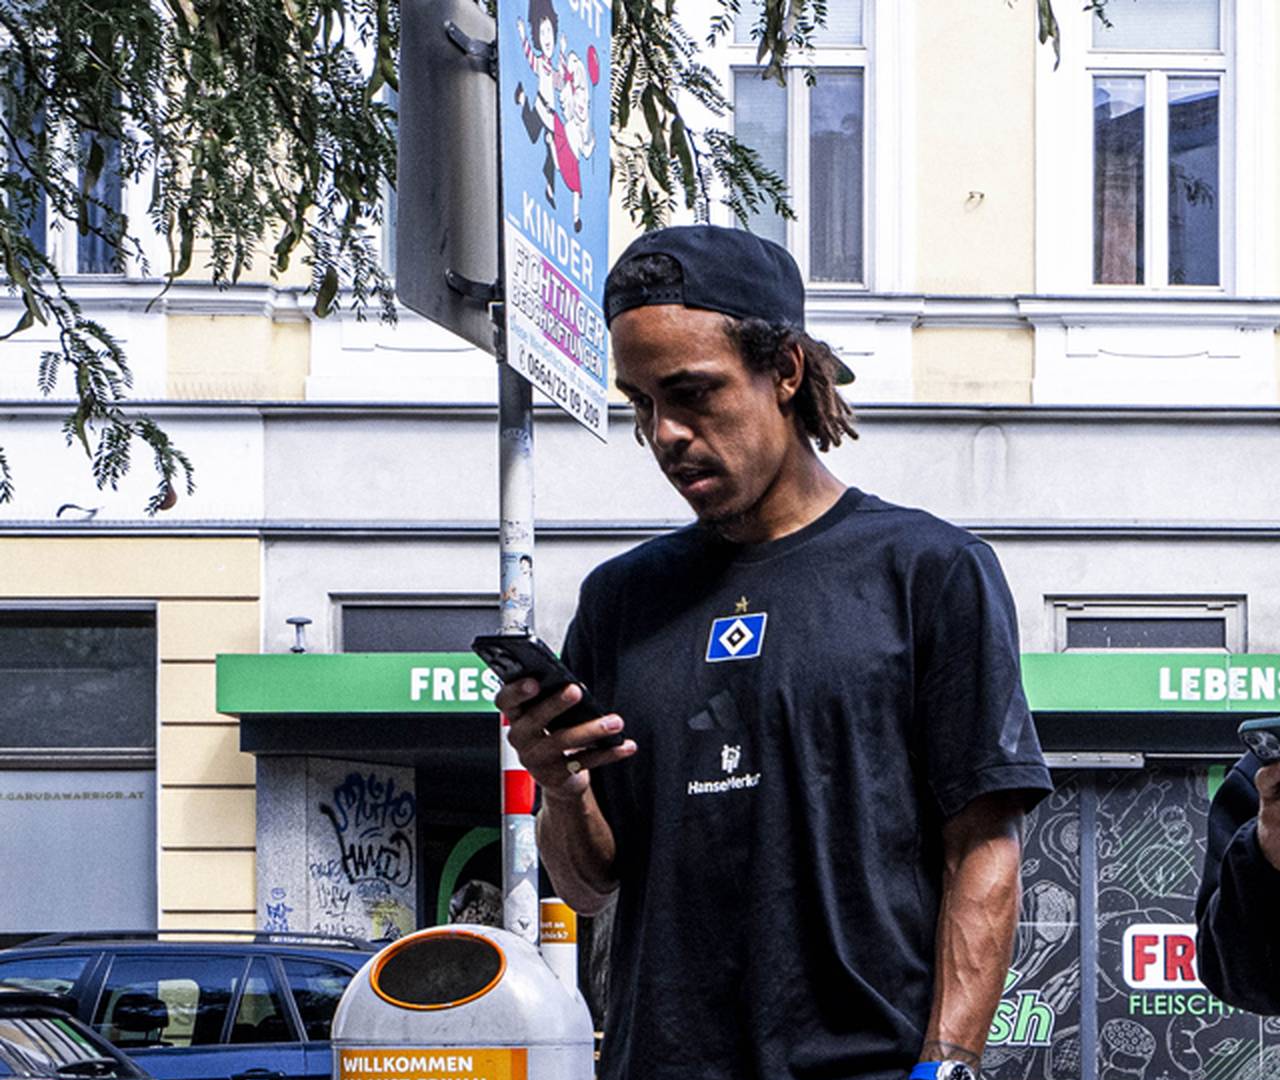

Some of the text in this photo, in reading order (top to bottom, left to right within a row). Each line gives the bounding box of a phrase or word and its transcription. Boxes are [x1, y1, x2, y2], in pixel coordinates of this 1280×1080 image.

[522, 191, 594, 292] KINDER
[687, 773, 761, 795] HanseMerkur
[1129, 993, 1245, 1016] FLEISCH
[343, 1056, 473, 1073] WILLKOMMEN
